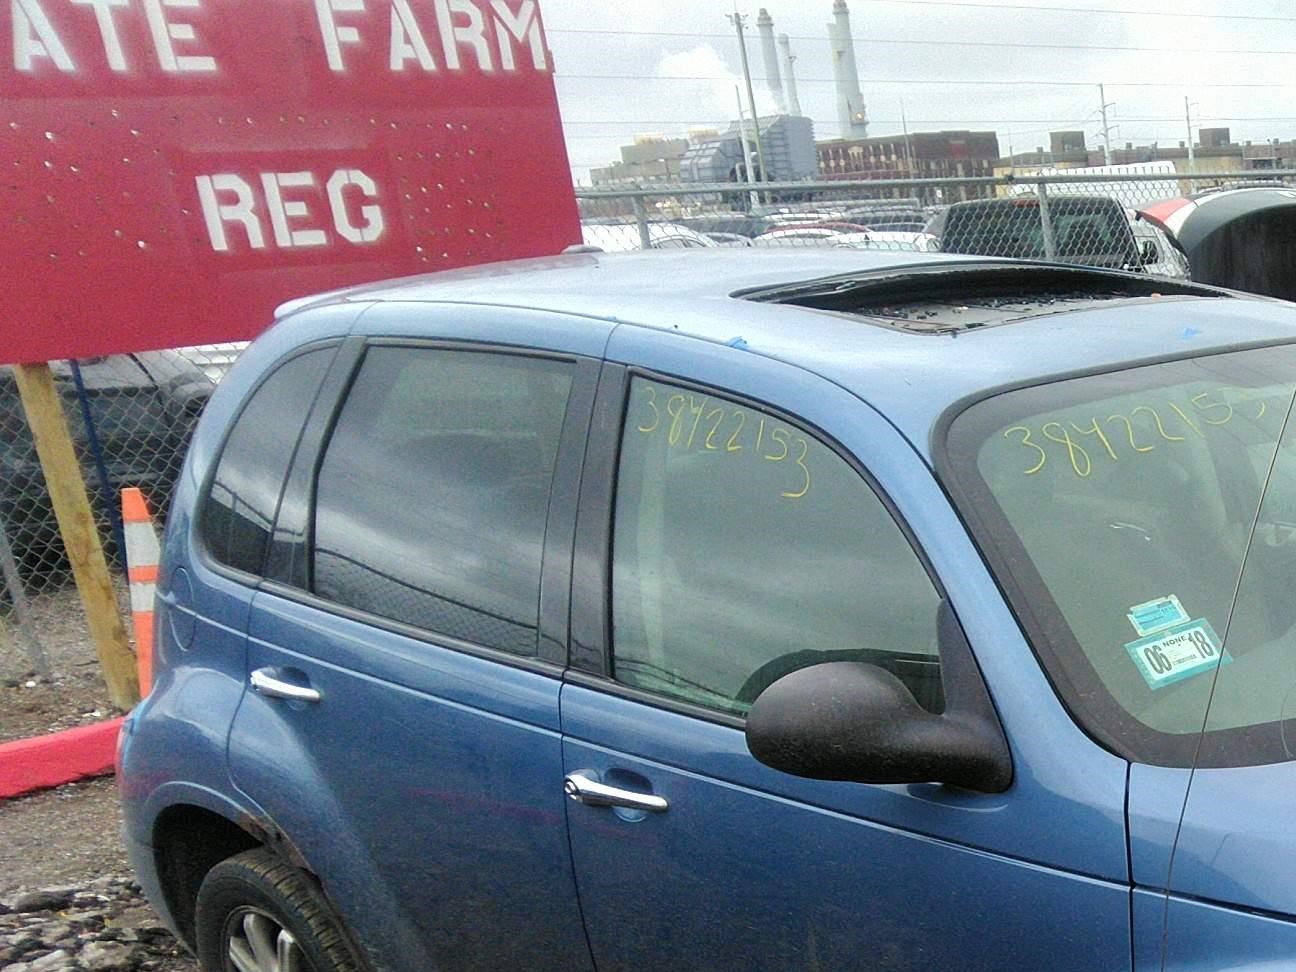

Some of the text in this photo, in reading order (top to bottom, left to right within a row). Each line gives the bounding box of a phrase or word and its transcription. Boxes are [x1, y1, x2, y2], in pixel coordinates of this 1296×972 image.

[315, 0, 547, 71] FARM
[195, 168, 385, 252] REG
[637, 385, 811, 499] 38422153
[1143, 645, 1173, 675] 06
